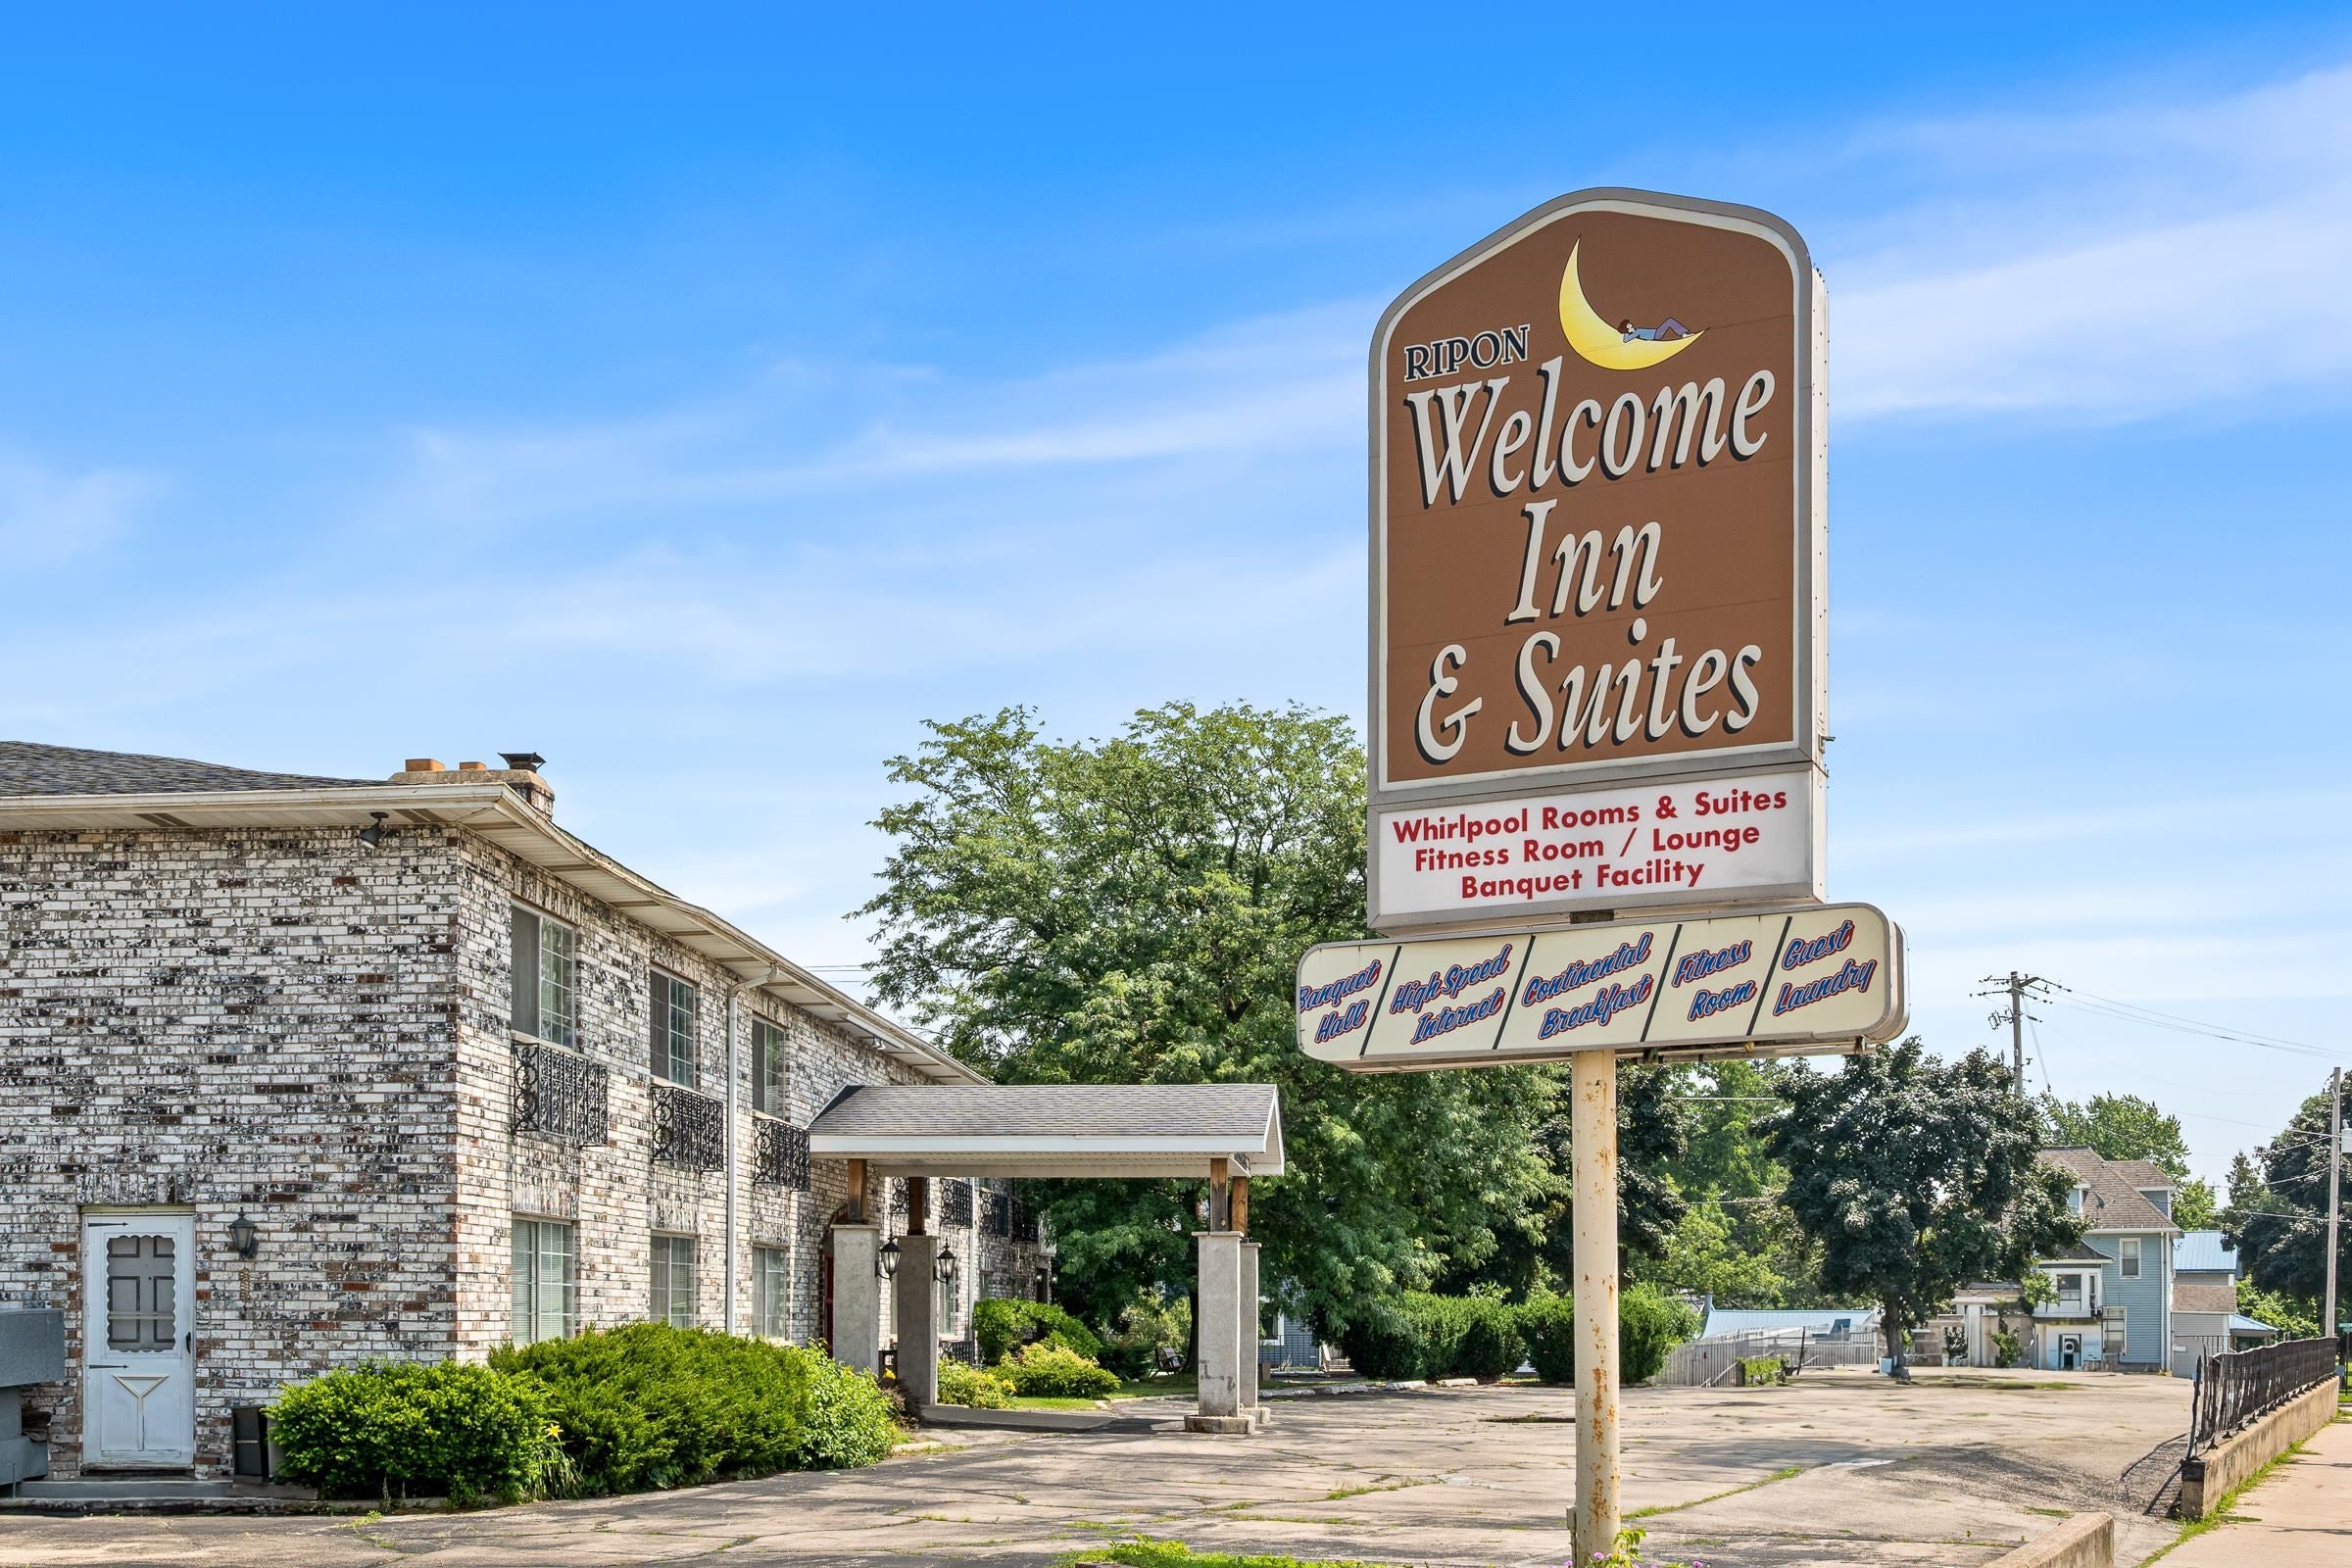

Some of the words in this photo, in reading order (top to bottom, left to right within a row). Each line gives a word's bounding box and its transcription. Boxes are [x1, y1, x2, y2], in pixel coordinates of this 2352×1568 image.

[1404, 323, 1530, 382] RIPON
[1404, 355, 1775, 509] Welcome
[1504, 498, 1663, 625] Inn
[1415, 644, 1483, 765] &
[1504, 617, 1762, 757] Suites
[1393, 808, 1528, 844] Whirlpool
[1543, 802, 1640, 830] Rooms
[1656, 795, 1678, 819] &
[1695, 788, 1787, 816] Suites
[1416, 845, 1508, 872] Fitness
[1524, 836, 1604, 863] Room
[1620, 827, 1638, 857] /
[1653, 824, 1760, 856] Lounge
[1461, 868, 1583, 900] Banquet
[1597, 858, 1704, 889] Facility
[1522, 932, 1653, 1007] Continental
[1672, 940, 1752, 988] Fitness
[1781, 919, 1854, 970] Guest
[1299, 959, 1382, 1013] Banquet
[1390, 972, 1441, 1014] High
[1442, 944, 1512, 998] Speed
[1538, 974, 1654, 1040] Breakfast
[1687, 979, 1756, 1021] Room
[1773, 957, 1877, 1016] Laundry
[1314, 1000, 1369, 1043] Hall
[1410, 990, 1505, 1045] Internet
